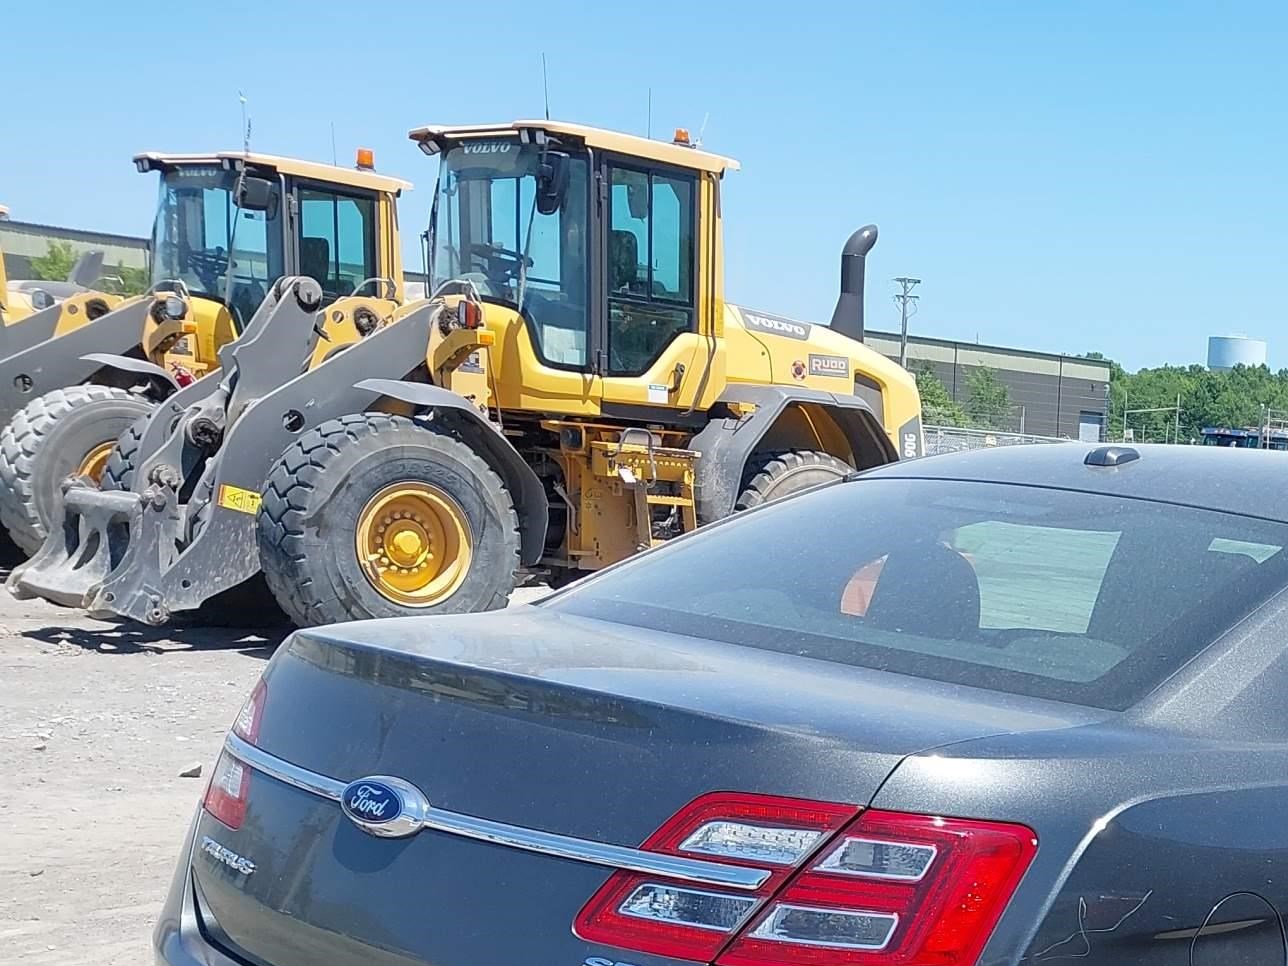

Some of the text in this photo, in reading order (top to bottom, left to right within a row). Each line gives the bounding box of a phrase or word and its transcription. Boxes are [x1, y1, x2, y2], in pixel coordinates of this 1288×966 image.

[463, 142, 511, 154] VOLVO
[745, 314, 806, 335] VOLVO
[351, 785, 389, 816] Ford
[201, 836, 257, 875] TAURUS
